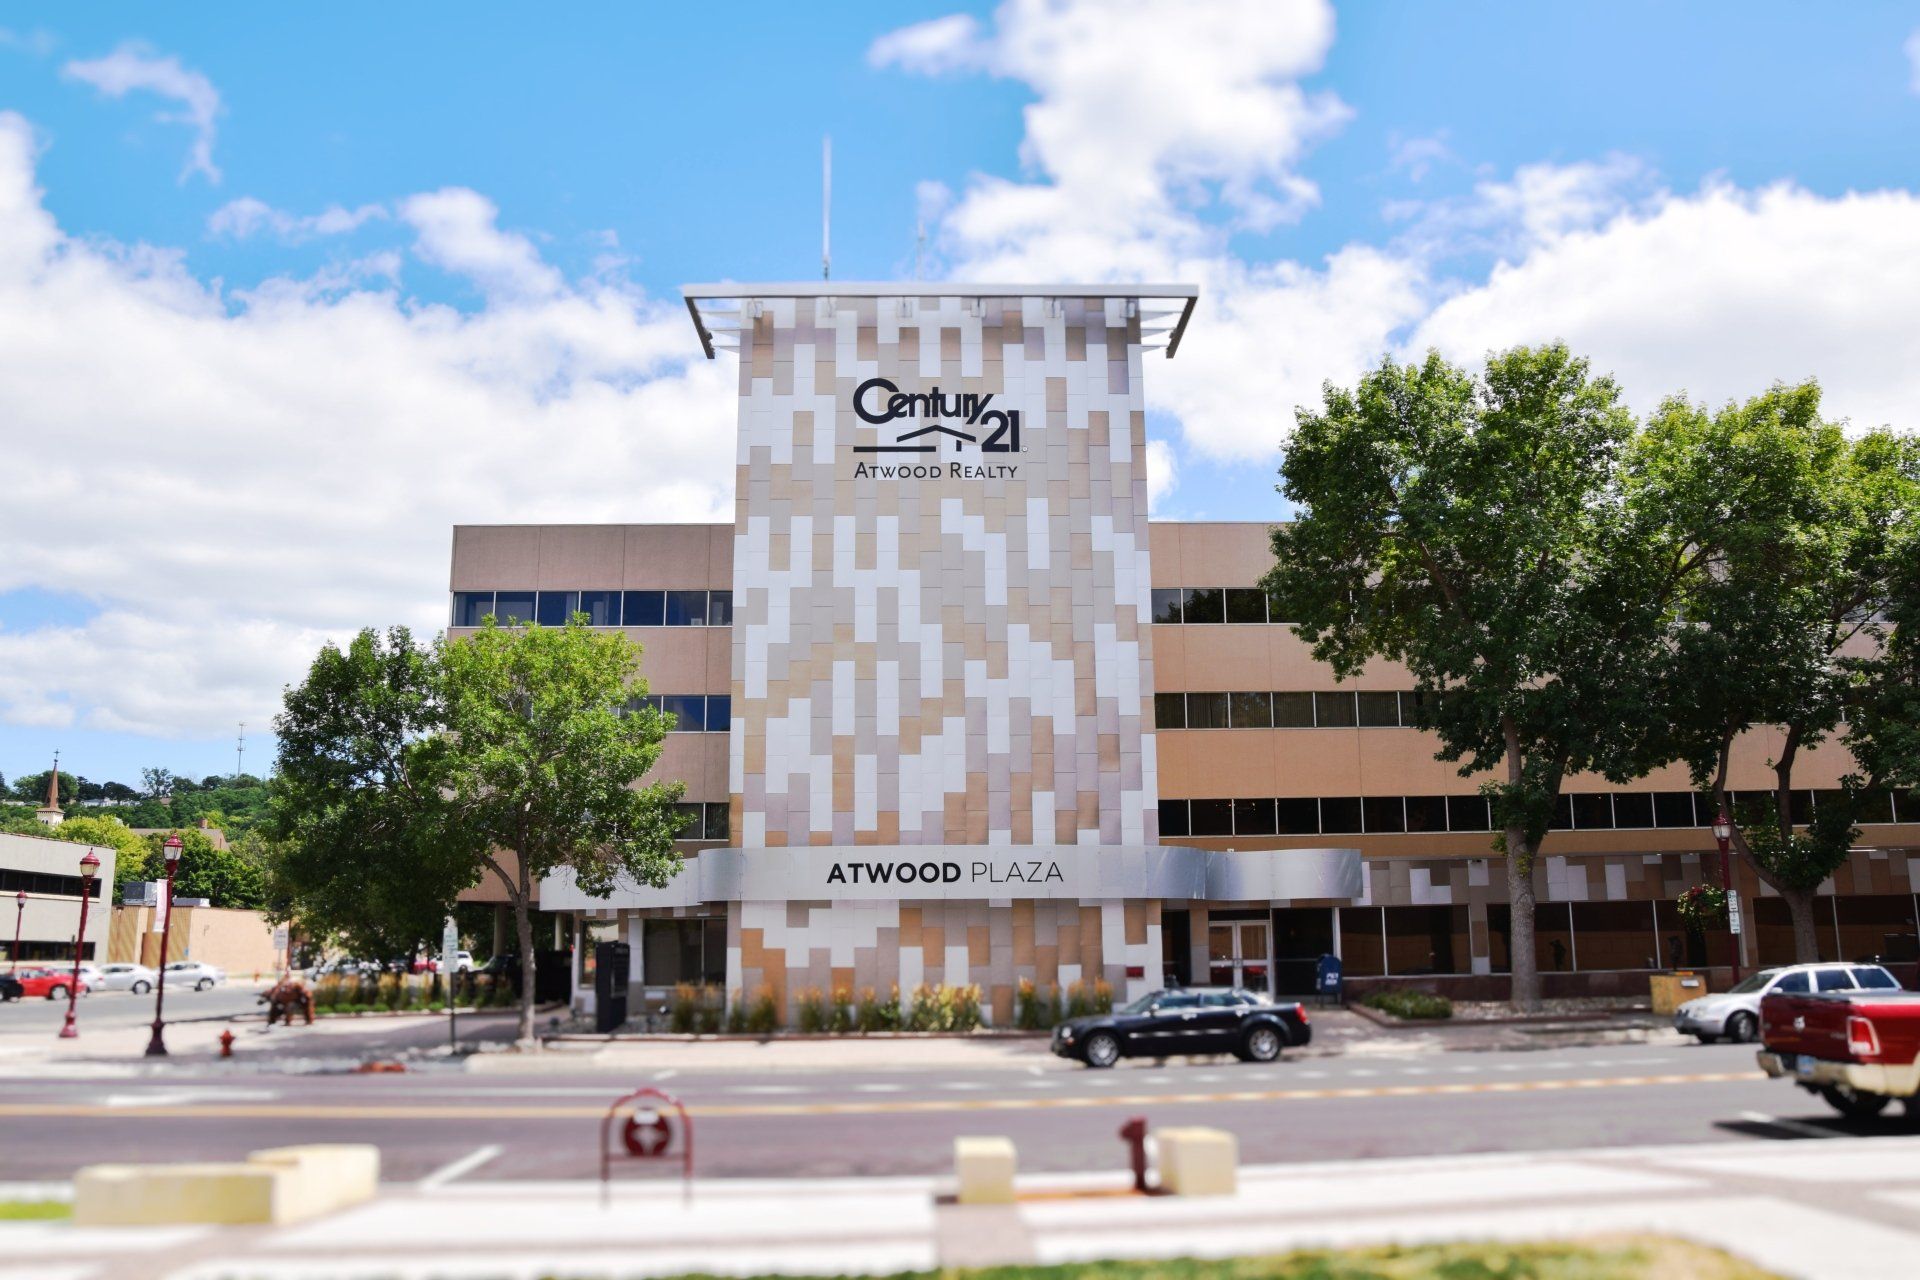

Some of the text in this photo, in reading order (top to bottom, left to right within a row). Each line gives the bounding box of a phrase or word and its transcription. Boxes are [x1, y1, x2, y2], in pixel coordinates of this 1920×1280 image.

[853, 377, 1020, 453] Century 21
[854, 462, 1018, 479] ATWOOD REALTY
[826, 861, 1065, 884] ATWOOD PLAZA
